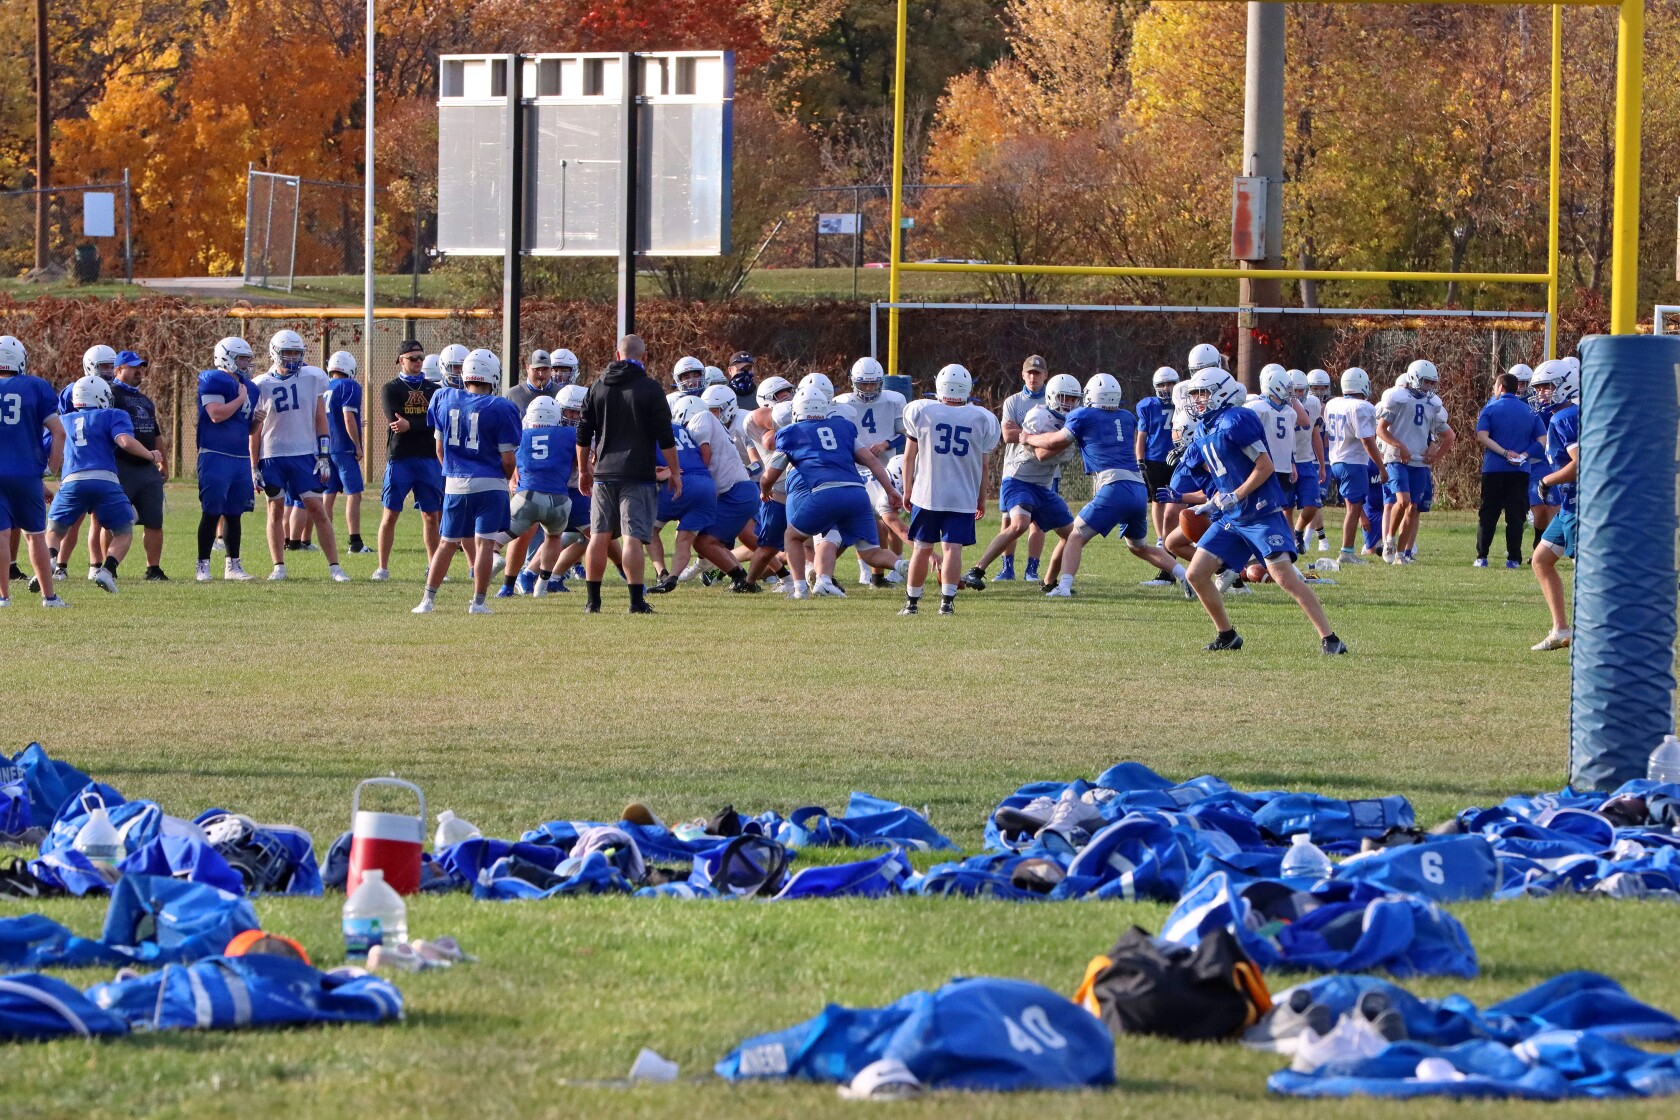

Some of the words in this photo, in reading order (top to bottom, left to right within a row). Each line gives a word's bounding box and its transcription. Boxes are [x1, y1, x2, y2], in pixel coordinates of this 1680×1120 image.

[0, 393, 22, 425] 3
[272, 383, 300, 413] 21
[449, 409, 479, 450] 11
[862, 408, 876, 433] 4
[1276, 417, 1286, 439] 5
[1414, 404, 1425, 426] 8
[75, 416, 88, 447] 1
[817, 427, 837, 450] 8
[934, 423, 973, 457] 35
[1114, 419, 1124, 442] 1
[531, 435, 549, 460] 5
[1202, 442, 1227, 477] 11
[1420, 851, 1445, 885] 6
[1003, 1004, 1067, 1056] 40
